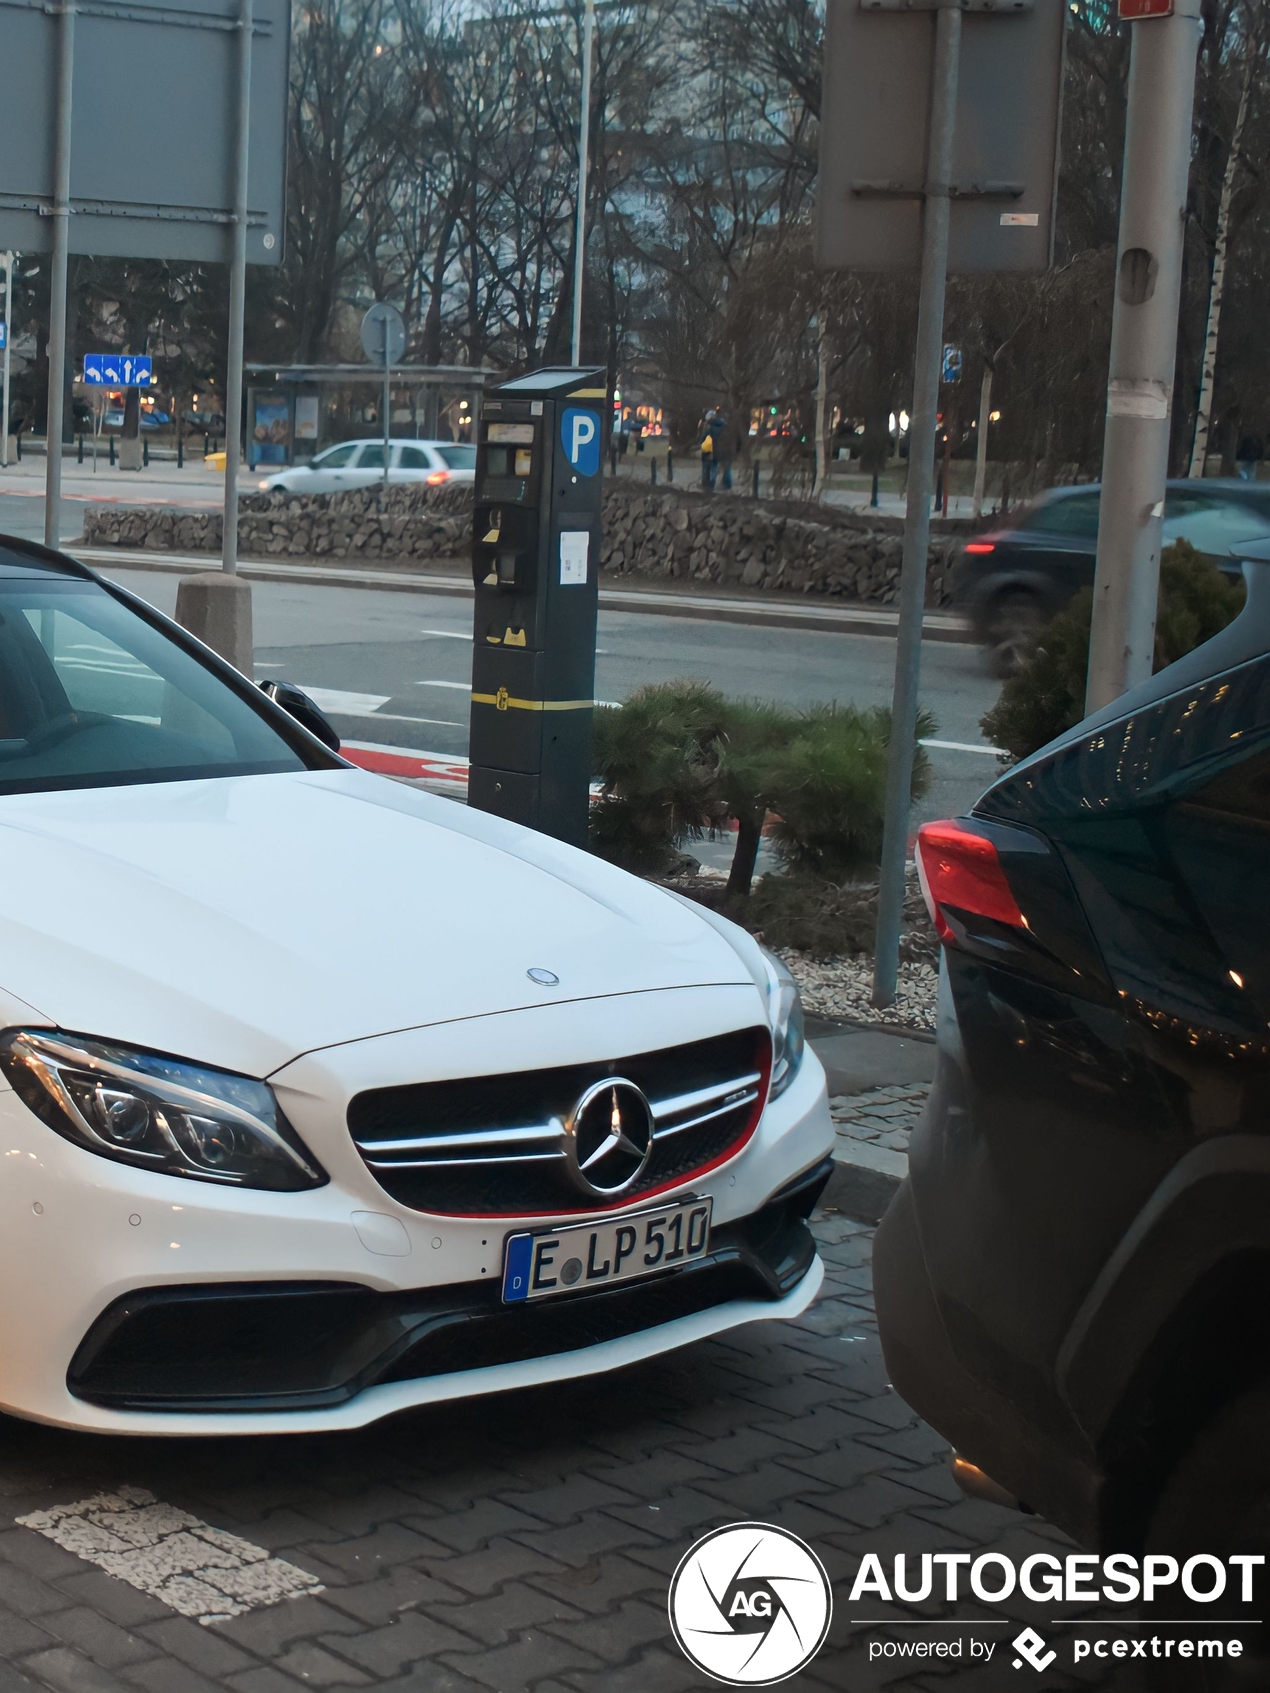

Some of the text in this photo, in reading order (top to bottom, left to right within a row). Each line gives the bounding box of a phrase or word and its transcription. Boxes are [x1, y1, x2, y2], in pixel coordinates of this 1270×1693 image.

[571, 415, 596, 464] P
[513, 1276, 521, 1290] D
[532, 1240, 560, 1290] E
